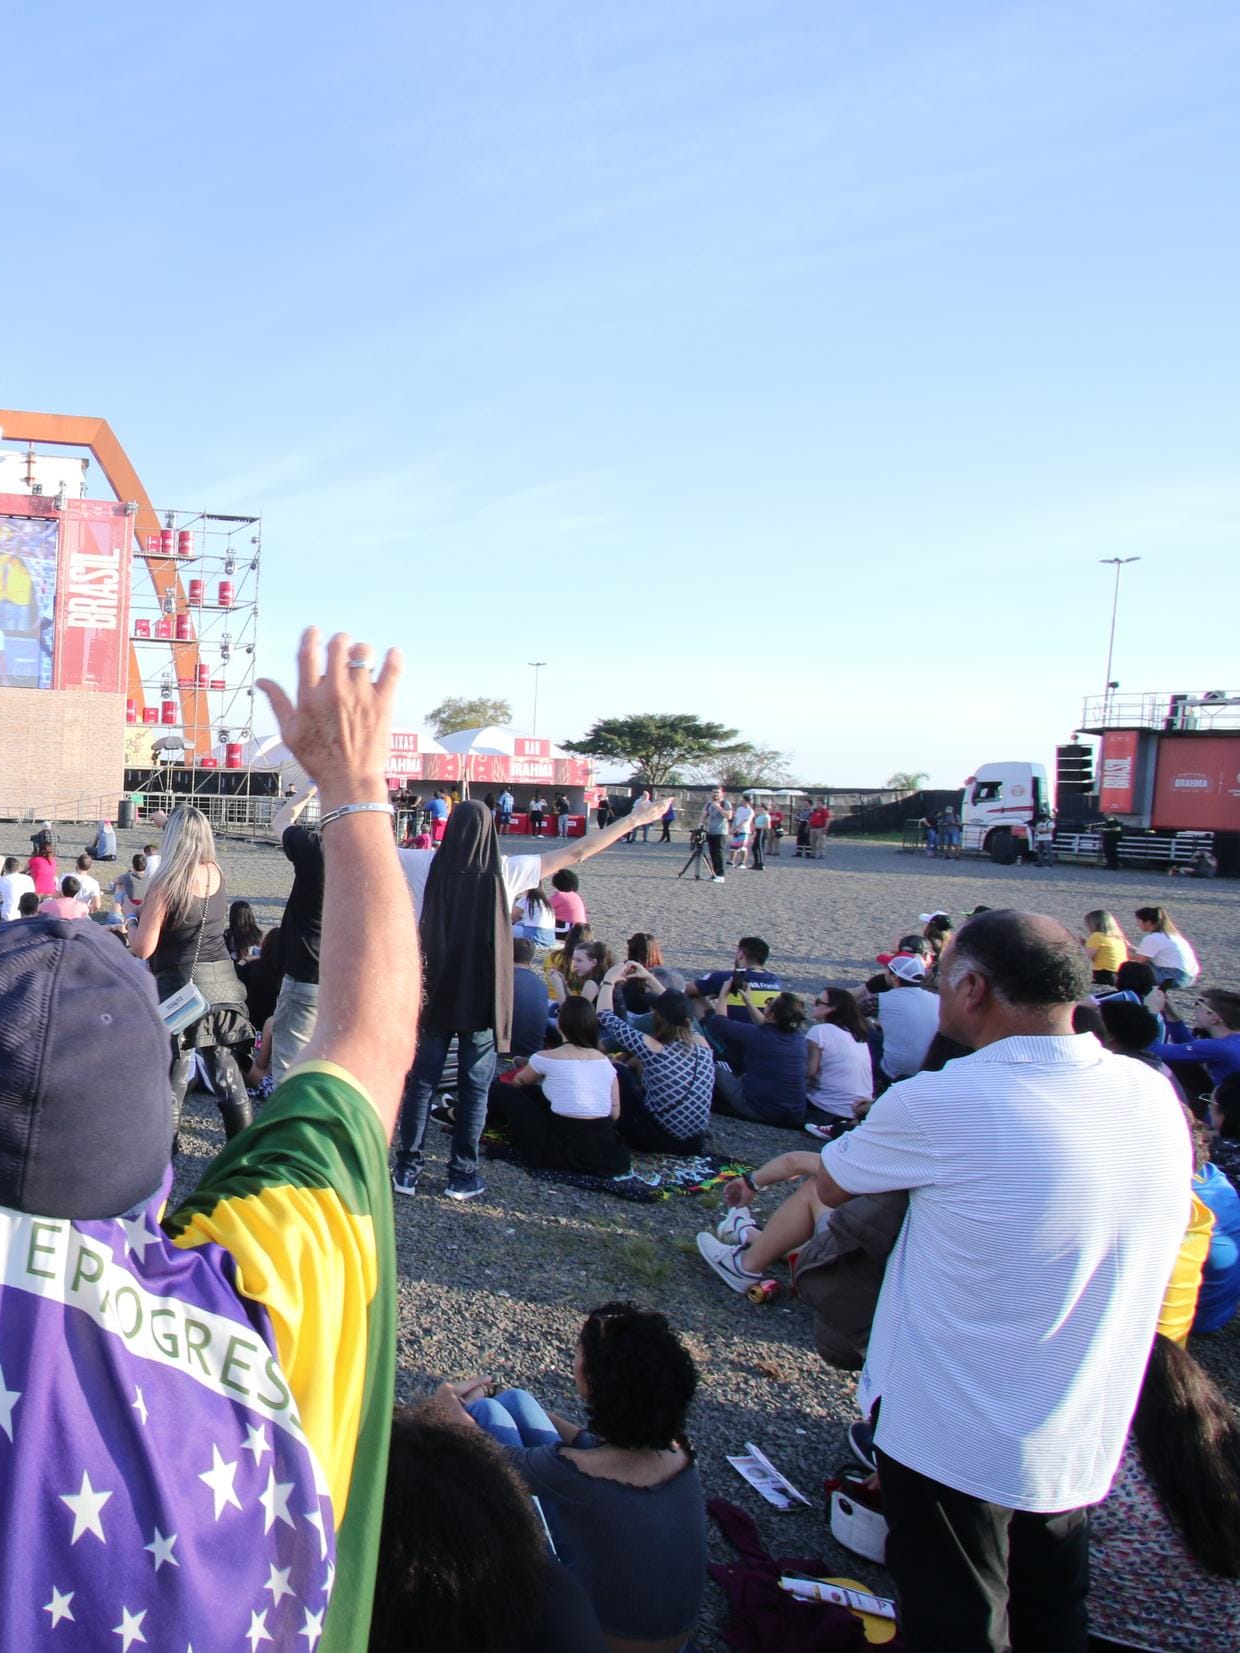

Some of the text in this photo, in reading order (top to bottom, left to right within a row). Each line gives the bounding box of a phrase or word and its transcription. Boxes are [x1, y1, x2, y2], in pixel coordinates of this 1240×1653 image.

[67, 548, 120, 630] BRASIL
[390, 735, 415, 750] AIXAS
[524, 740, 540, 755] BAR
[384, 757, 421, 772] RAHMA
[510, 761, 553, 777] BRAHMA
[27, 1221, 64, 1280] E
[71, 1245, 302, 1431] POGRES
